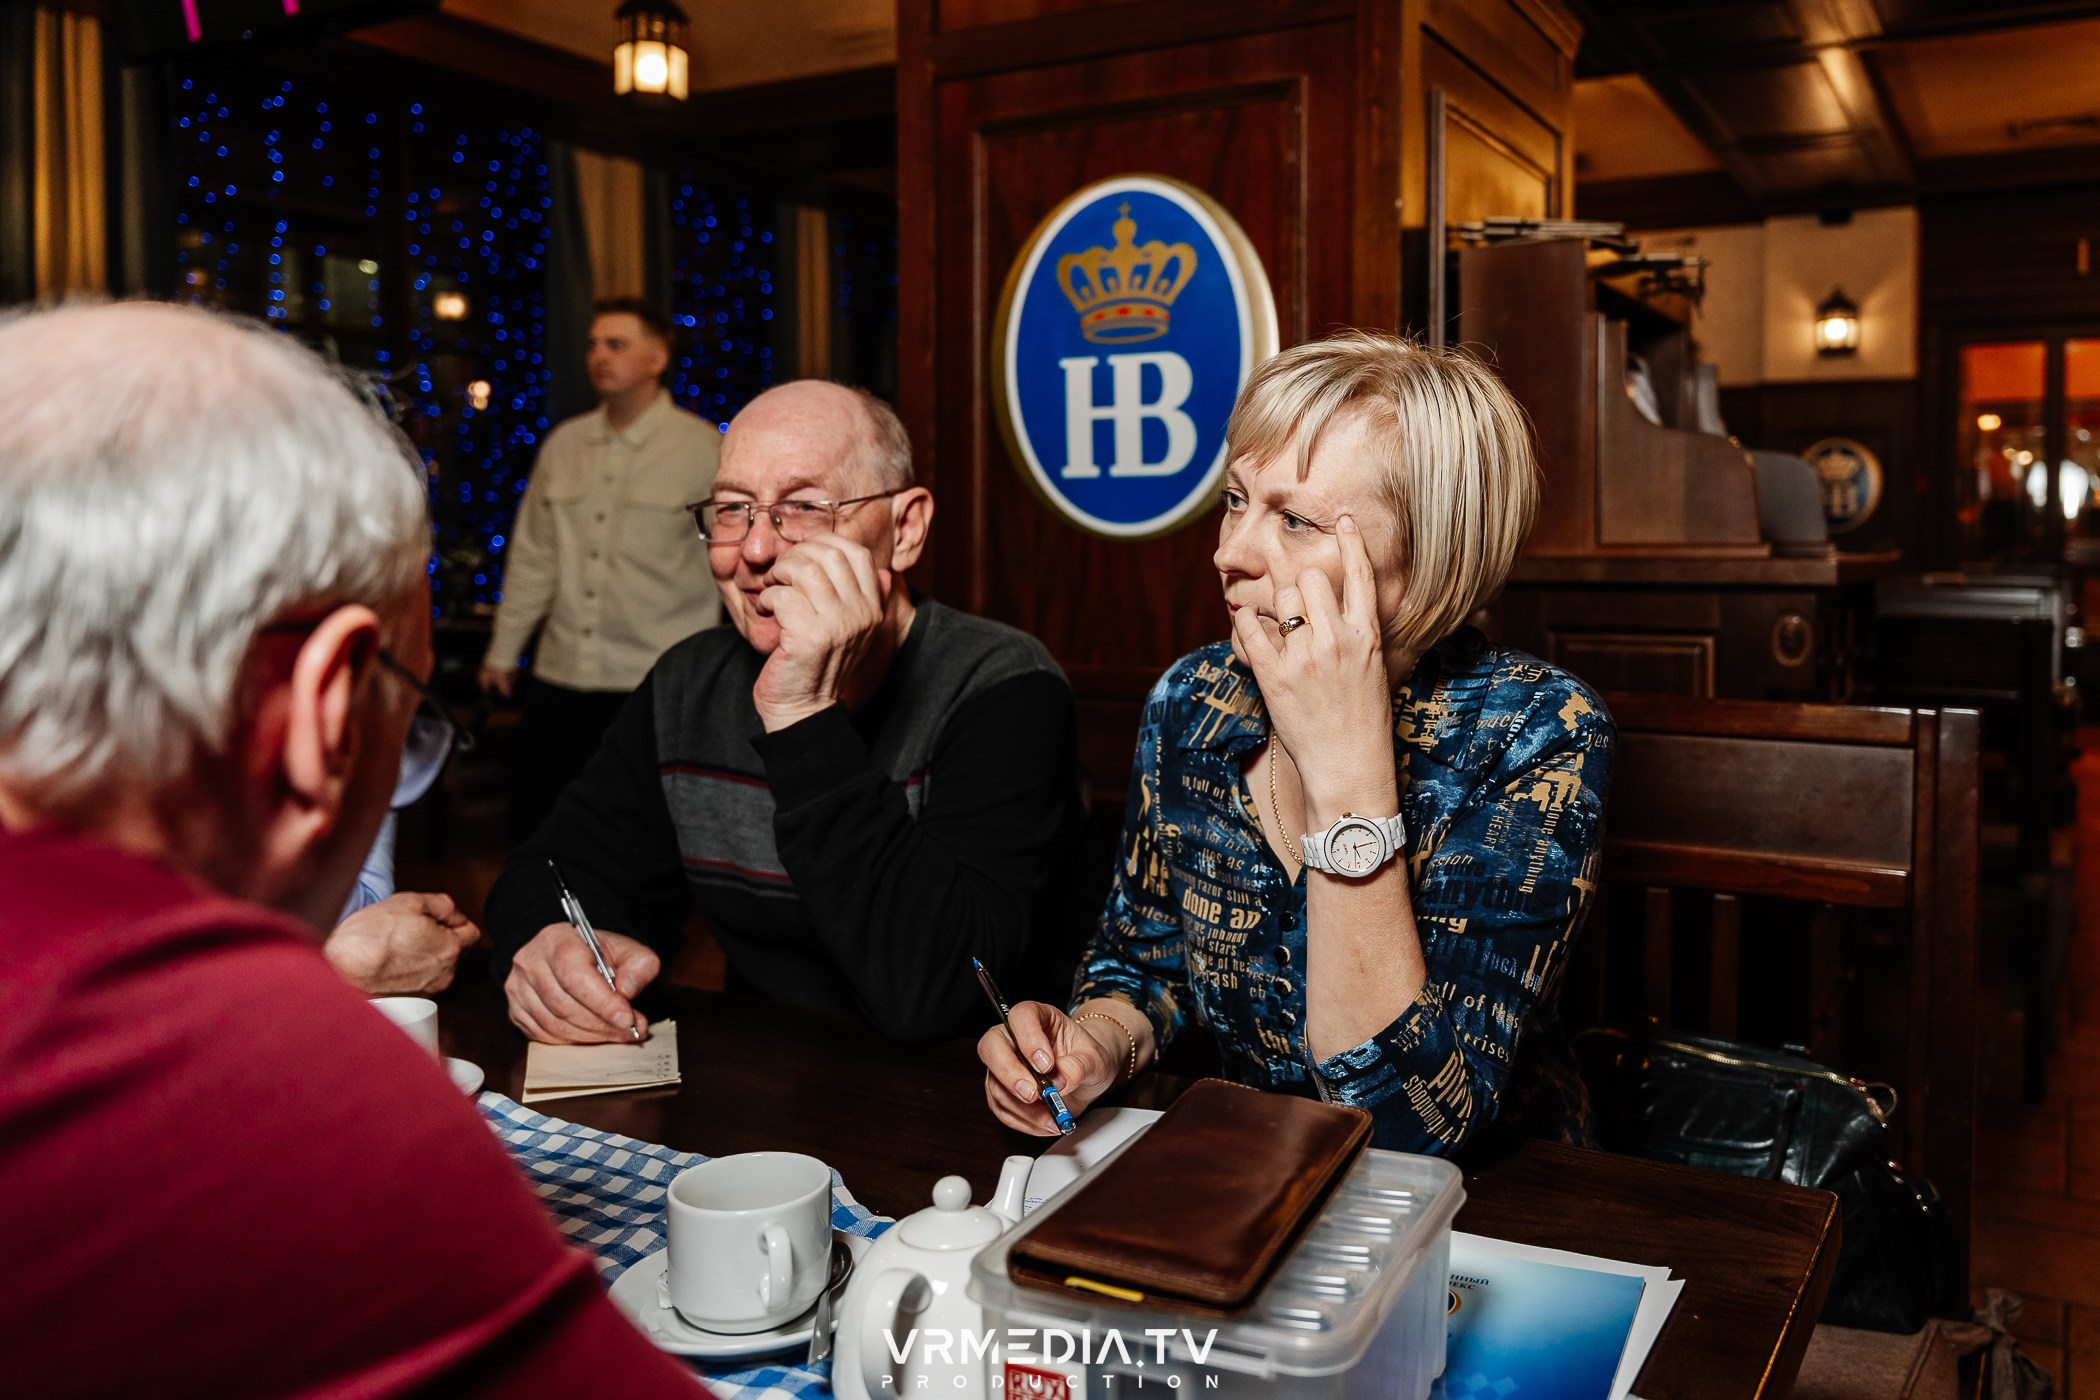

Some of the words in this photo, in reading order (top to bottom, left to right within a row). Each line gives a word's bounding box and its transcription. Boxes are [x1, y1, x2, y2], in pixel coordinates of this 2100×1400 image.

[1059, 351, 1198, 479] HB
[1519, 839, 1551, 894] anything
[1183, 886, 1222, 925] done
[1139, 941, 1184, 961] which
[1209, 940, 1237, 957] stars
